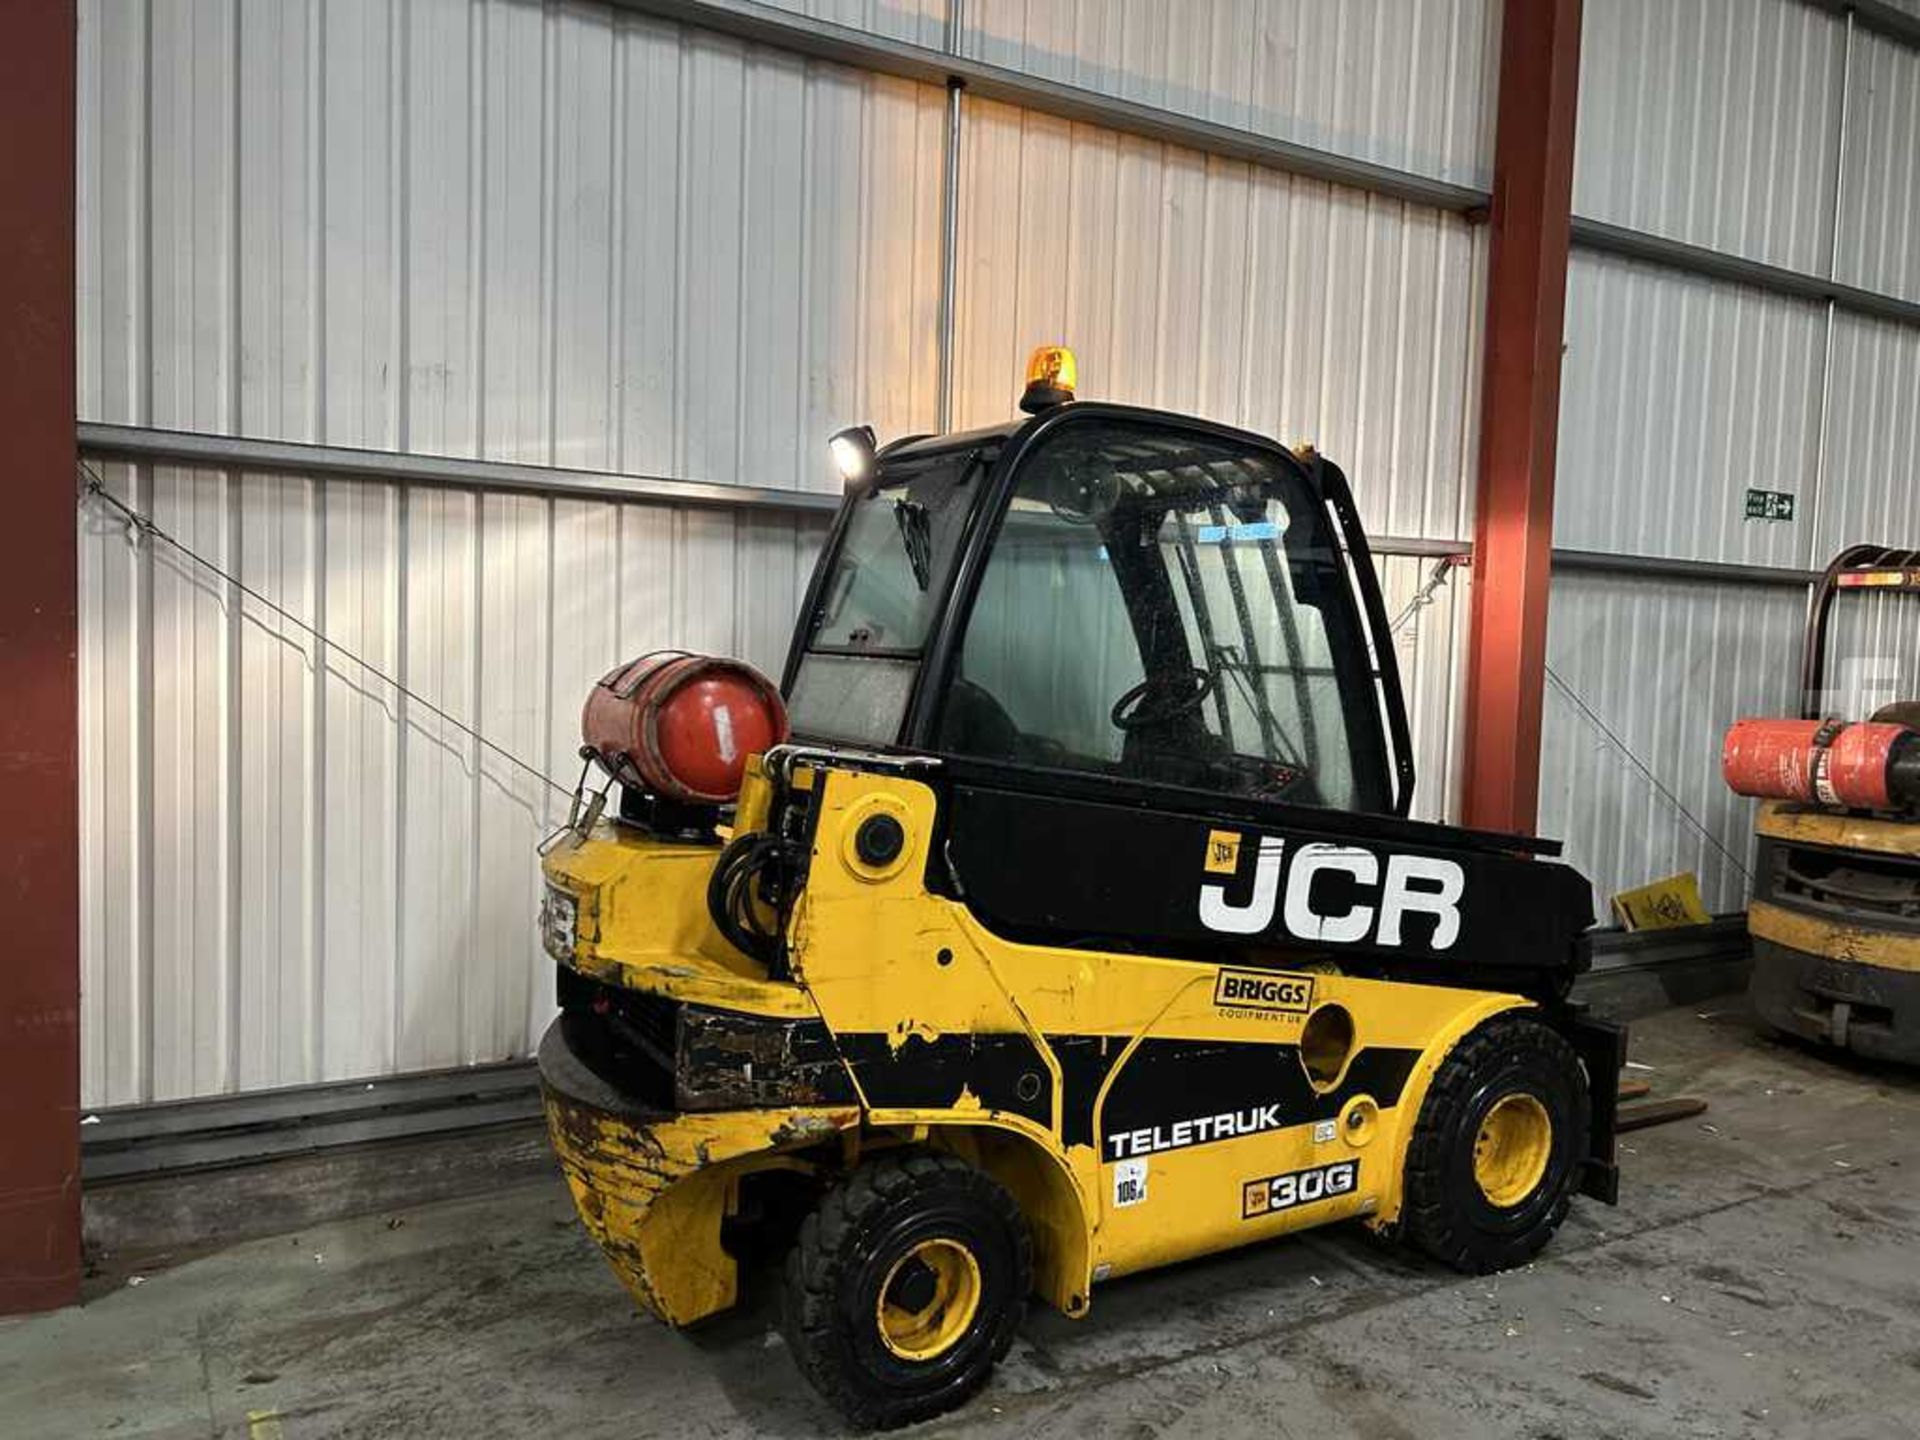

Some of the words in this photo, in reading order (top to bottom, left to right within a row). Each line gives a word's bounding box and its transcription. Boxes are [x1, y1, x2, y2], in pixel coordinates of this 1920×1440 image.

[1224, 977, 1305, 1003] BRIGGS
[1108, 1103, 1280, 1157] TELETRUK
[1270, 1163, 1354, 1209] 30G
